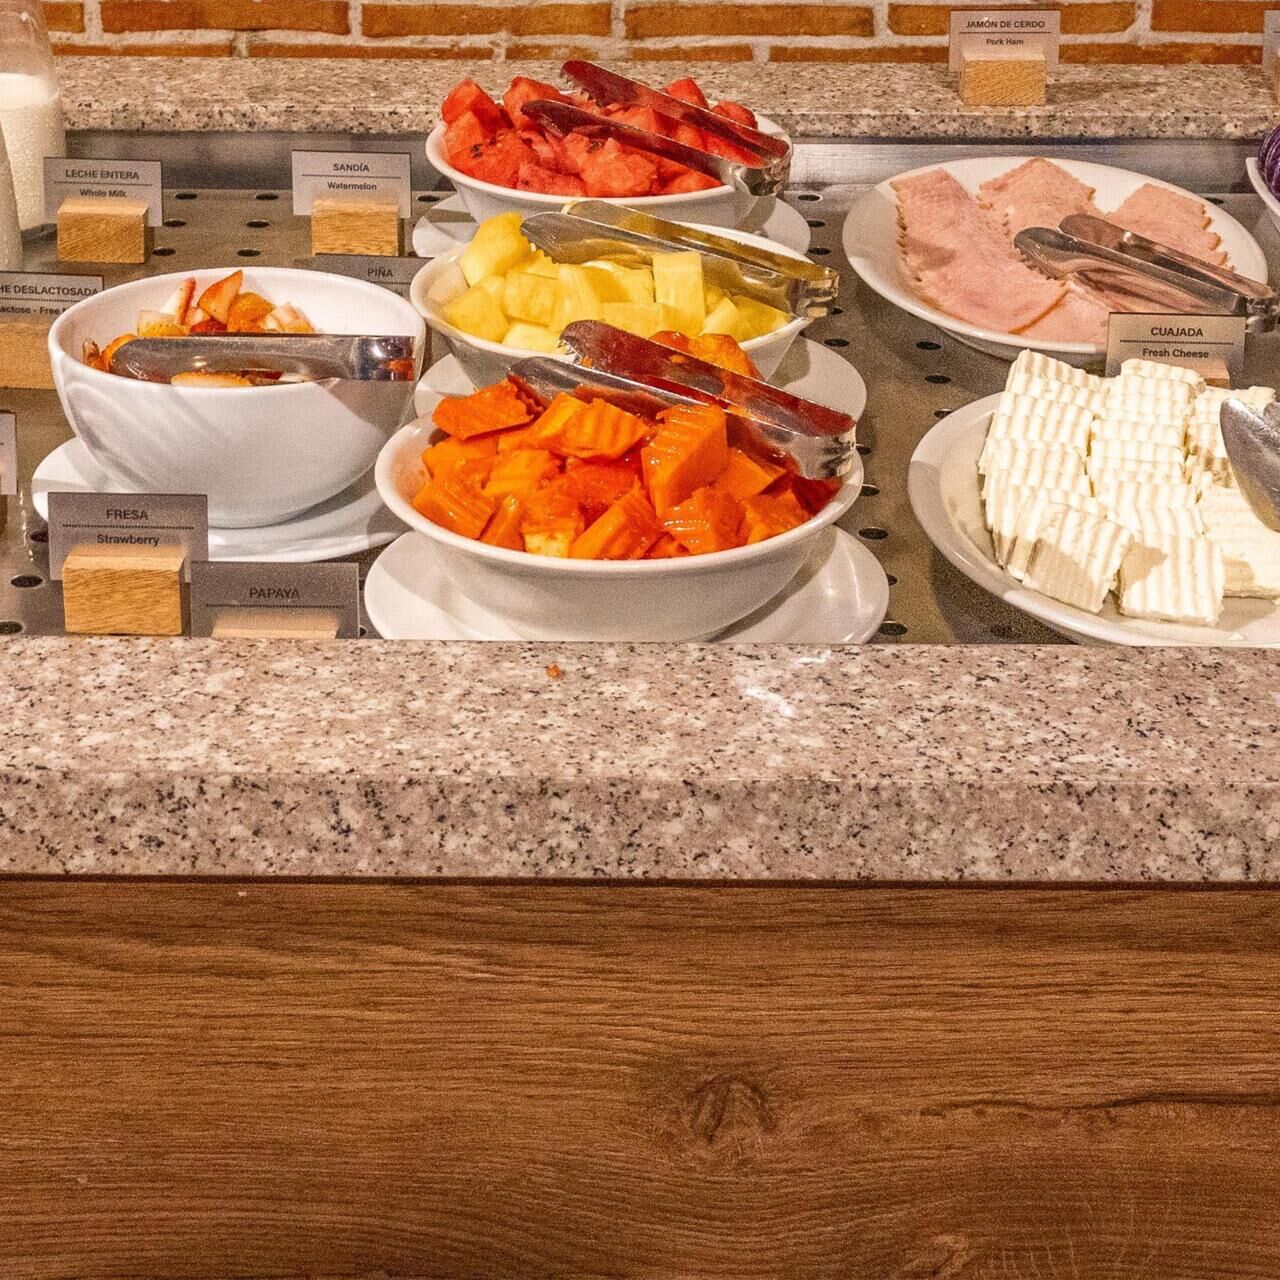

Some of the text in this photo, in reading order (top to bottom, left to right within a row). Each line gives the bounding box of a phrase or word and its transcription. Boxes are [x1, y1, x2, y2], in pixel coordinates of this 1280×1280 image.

[966, 19, 1045, 28] JAMÓN DE CERDO
[333, 163, 370, 172] SANDÍA
[65, 169, 139, 180] LECHE ENTERA
[327, 181, 377, 190] Watermelon
[80, 189, 107, 197] Whole
[368, 266, 394, 277] PIÑA
[13, 285, 98, 296] DESLACTOSADA
[39, 306, 60, 315] Free
[1151, 327, 1204, 337] CUAJADA
[1143, 348, 1209, 358] Fresh Cheese
[106, 509, 148, 520] FRESA
[97, 534, 160, 547] Strawberry
[249, 587, 300, 598] PAPAYA
